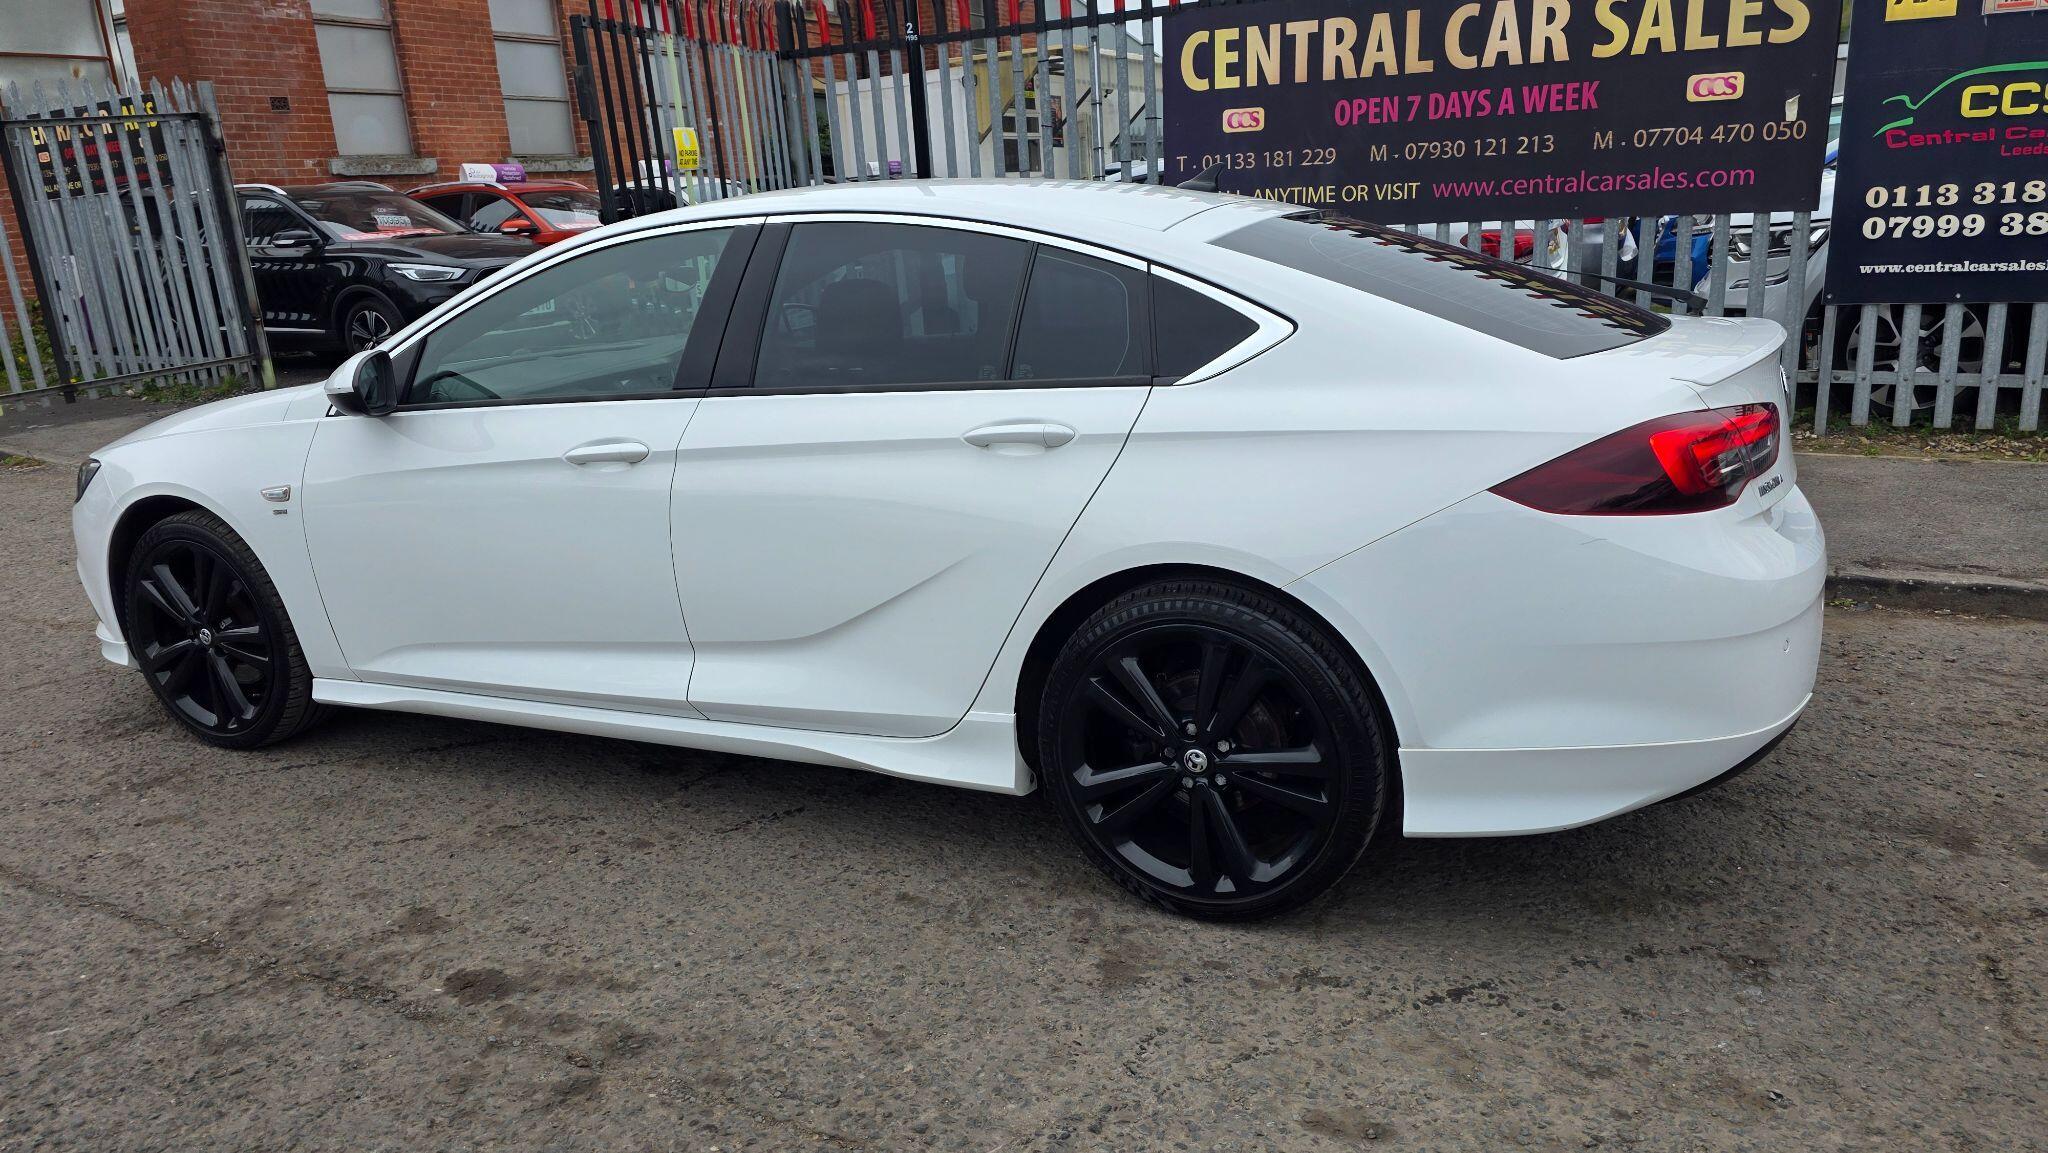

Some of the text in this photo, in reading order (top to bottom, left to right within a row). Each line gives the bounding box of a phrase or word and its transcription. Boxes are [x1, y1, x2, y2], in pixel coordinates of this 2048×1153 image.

[906, 22, 913, 33] 2
[1181, 0, 1811, 91] CENTRAL CAR SALES
[1334, 80, 1600, 126] OPEN 7 DAYS A WEEK
[1404, 140, 1466, 160] 07930
[1474, 138, 1508, 156] 121
[1516, 134, 1555, 155] 213
[1633, 126, 1703, 148] 07704
[1710, 123, 1755, 144] 470
[1762, 120, 1807, 141] 050
[1885, 126, 2048, 149] Central Ca
[1263, 150, 1293, 168] 181
[1301, 147, 1337, 166] 229
[1254, 166, 1755, 204] ANYTIME OR VISIT www.centralcarsales.com
[1865, 180, 2047, 208] 0113 318
[1862, 211, 2048, 240] 07999 38
[1859, 259, 2048, 274] www.centralcarsales
